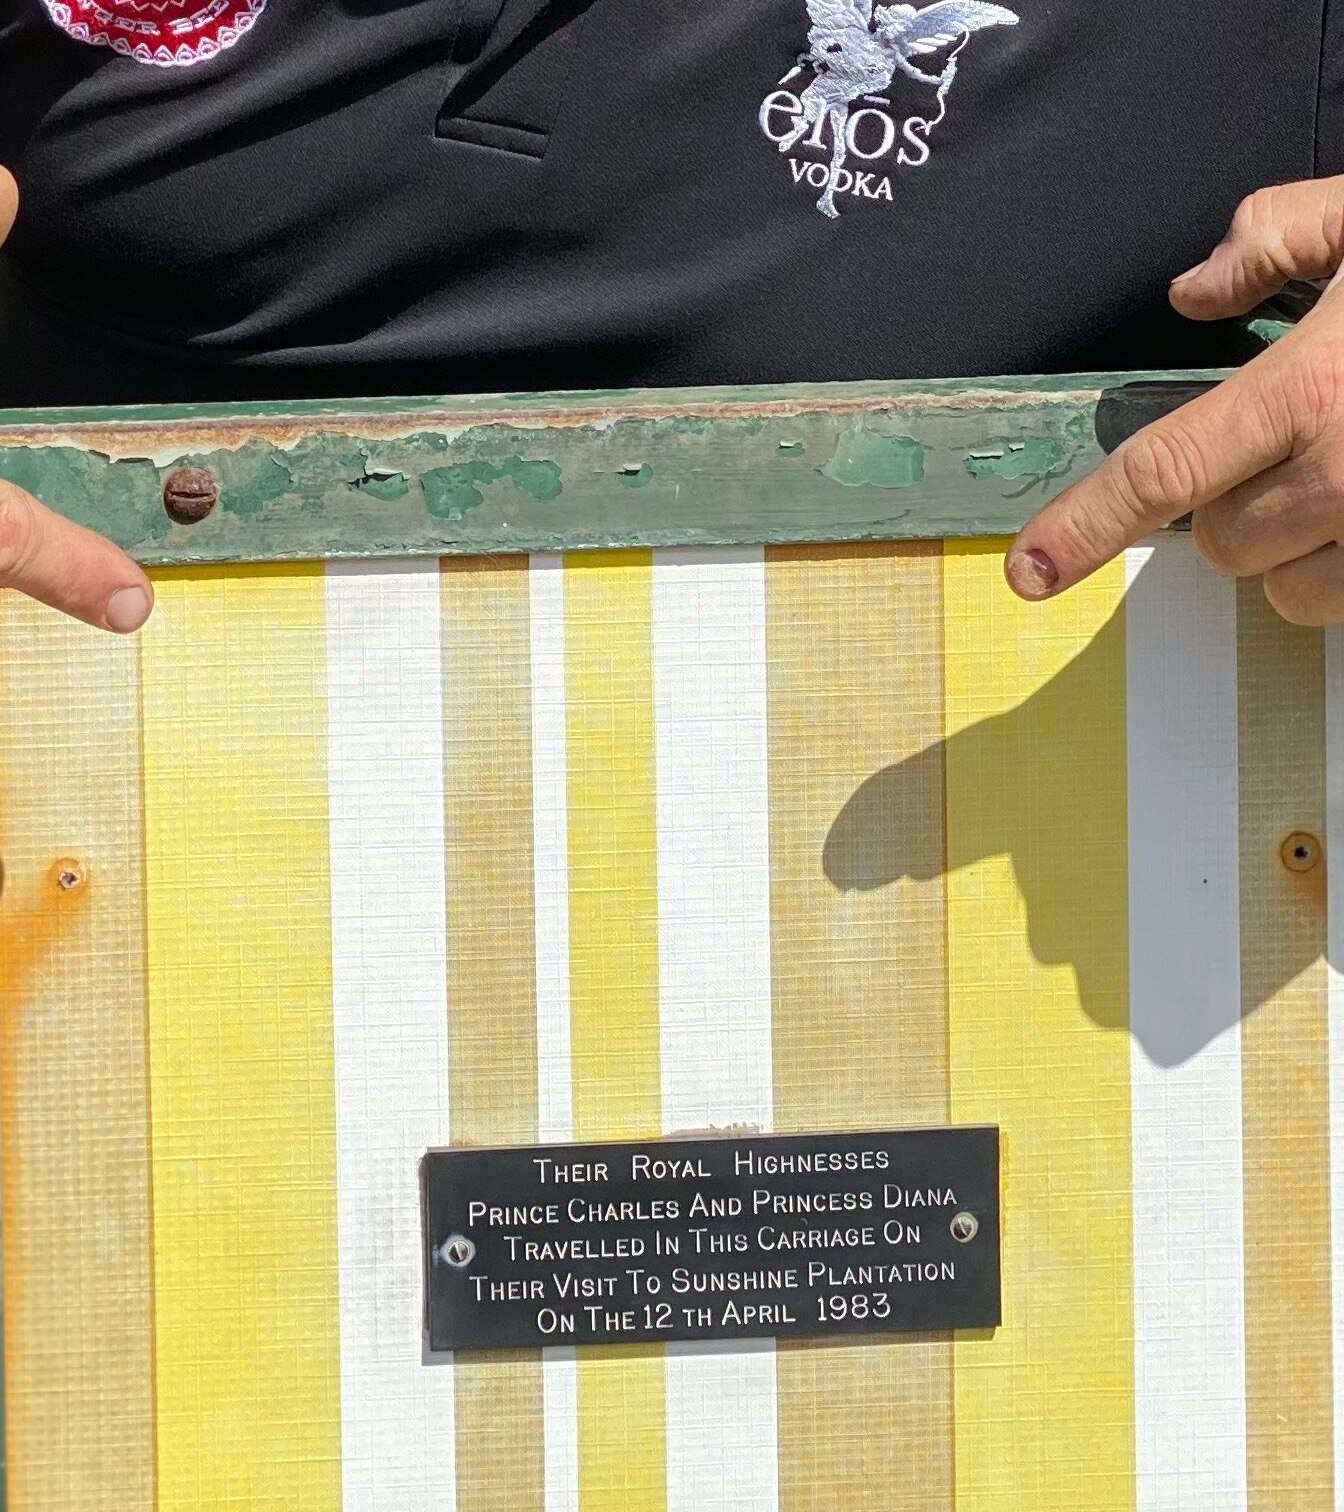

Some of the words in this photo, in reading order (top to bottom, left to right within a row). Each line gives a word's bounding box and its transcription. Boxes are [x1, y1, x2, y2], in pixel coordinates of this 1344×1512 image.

[787, 158, 894, 201] VODKA
[533, 1158, 609, 1184] THEIR
[632, 1154, 712, 1181] ROYAL
[734, 1150, 889, 1176] HIGHNESSES
[468, 1201, 560, 1227] PRINCE
[567, 1198, 680, 1223] CHARLES
[688, 1192, 742, 1218] AND
[753, 1189, 873, 1215] PRINCESS
[883, 1184, 958, 1209] DIANA
[503, 1235, 645, 1262] TRAVELLED
[656, 1230, 680, 1256] IN
[688, 1227, 748, 1254] THIS
[757, 1225, 876, 1251] CARRIAGE
[883, 1221, 921, 1245] ON
[468, 1275, 545, 1302] THEIR
[552, 1272, 618, 1299] VISIT
[625, 1269, 661, 1295] TO
[671, 1267, 799, 1293] SUNSHINE
[808, 1261, 955, 1287] PLANTATION
[537, 1307, 575, 1334] ON
[583, 1305, 636, 1332] THE
[643, 1303, 674, 1330] 12
[721, 1300, 797, 1326] APRIL
[817, 1293, 891, 1322] 1983
